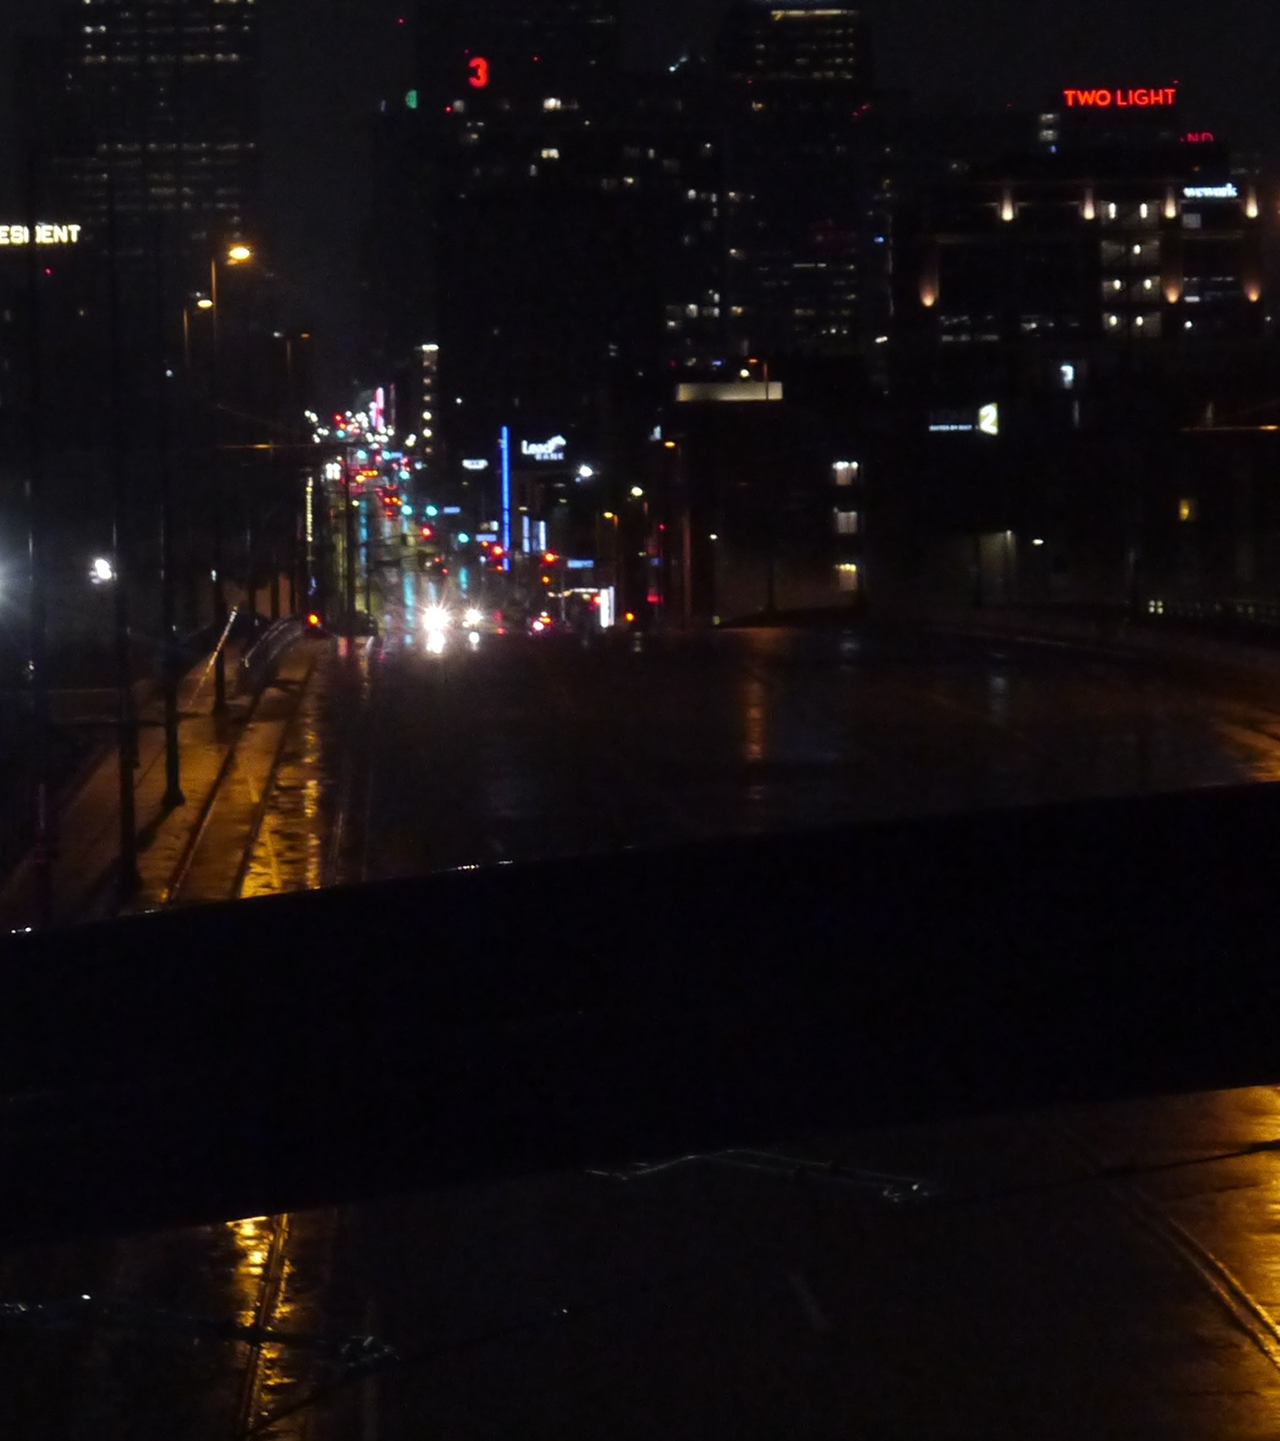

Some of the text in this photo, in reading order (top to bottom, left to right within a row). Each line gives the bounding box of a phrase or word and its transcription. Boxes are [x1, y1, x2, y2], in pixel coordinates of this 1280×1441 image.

[468, 57, 489, 89] 3
[1063, 89, 1174, 106] TWO LIGHT
